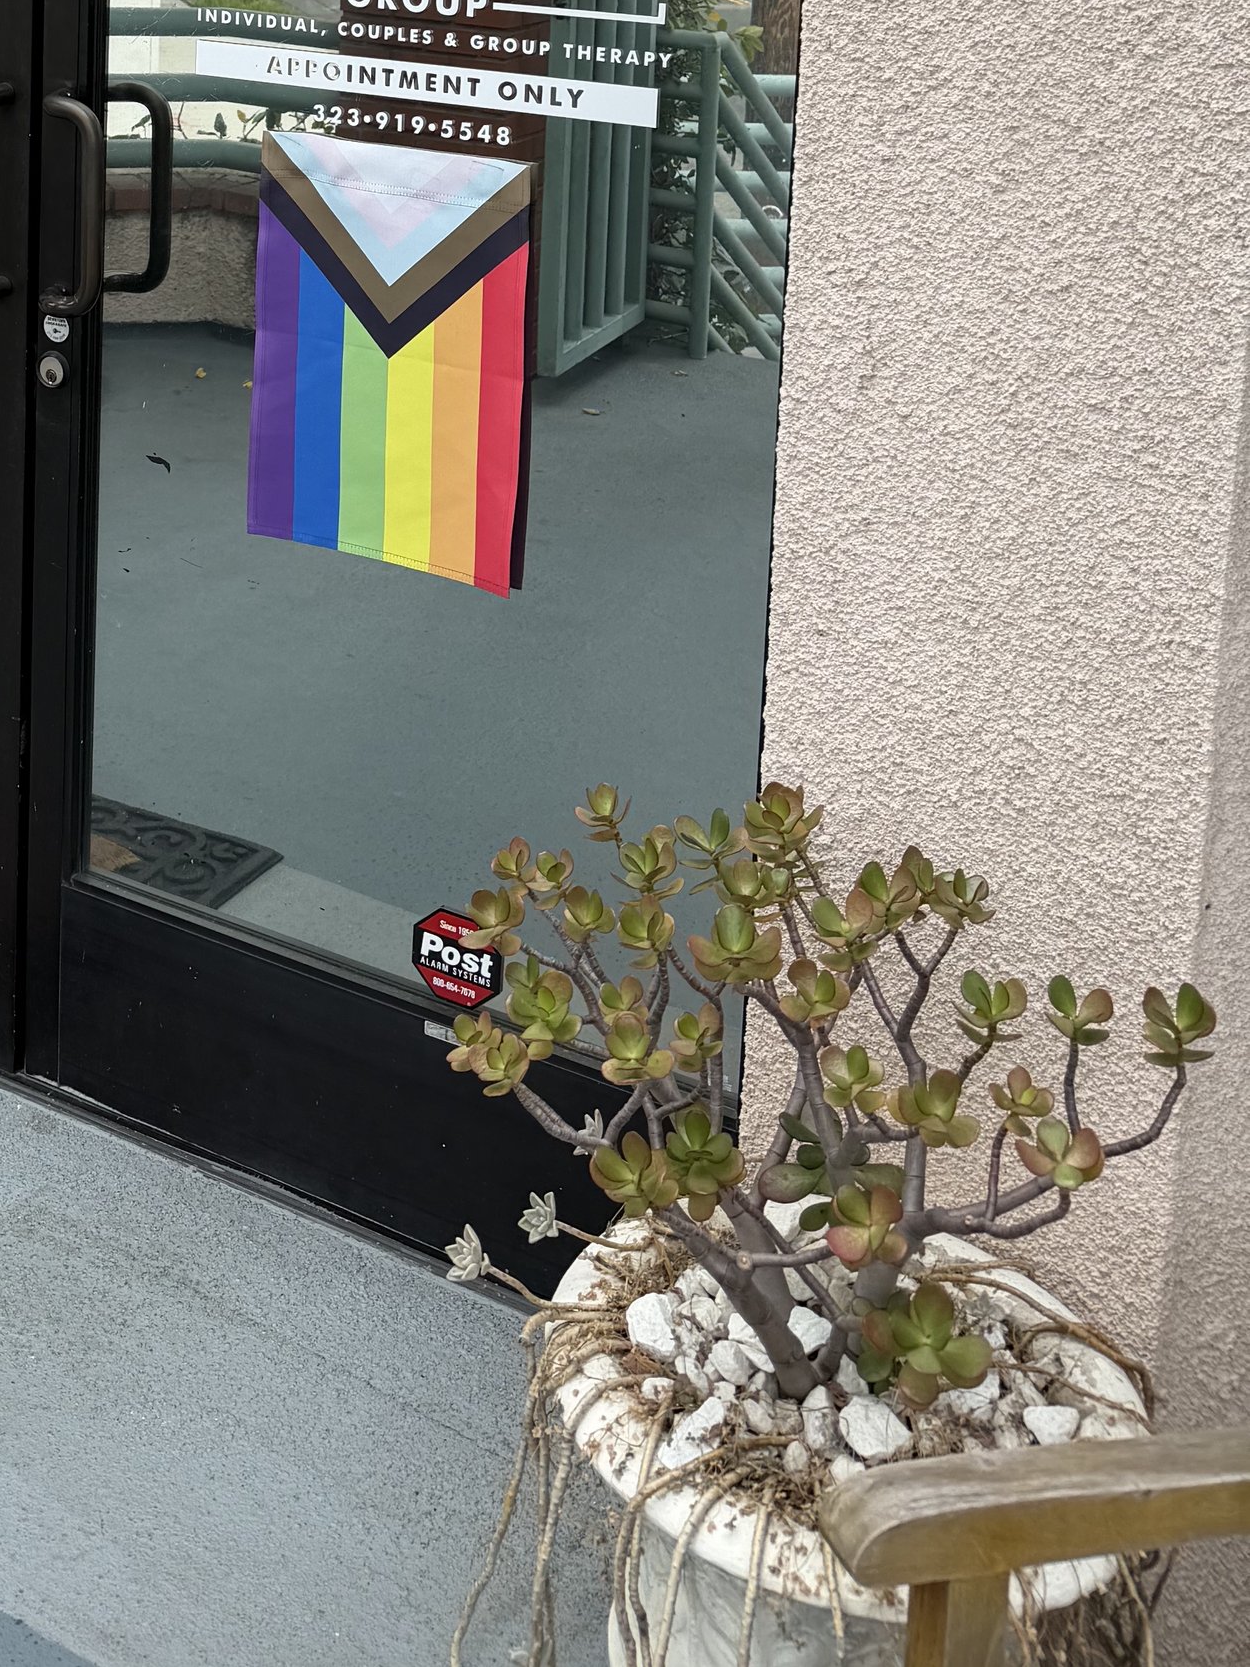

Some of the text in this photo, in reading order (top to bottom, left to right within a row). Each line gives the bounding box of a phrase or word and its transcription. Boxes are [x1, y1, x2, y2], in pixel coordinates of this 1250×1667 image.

[197, 7, 672, 69] INDIVIDUAL, COUPLES & GROUP THERAPY
[266, 56, 584, 108] APPOINTMENT ONLY
[439, 919, 457, 933] Since
[419, 956, 491, 987] ALARM SYSTEMS
[420, 931, 493, 978] Post
